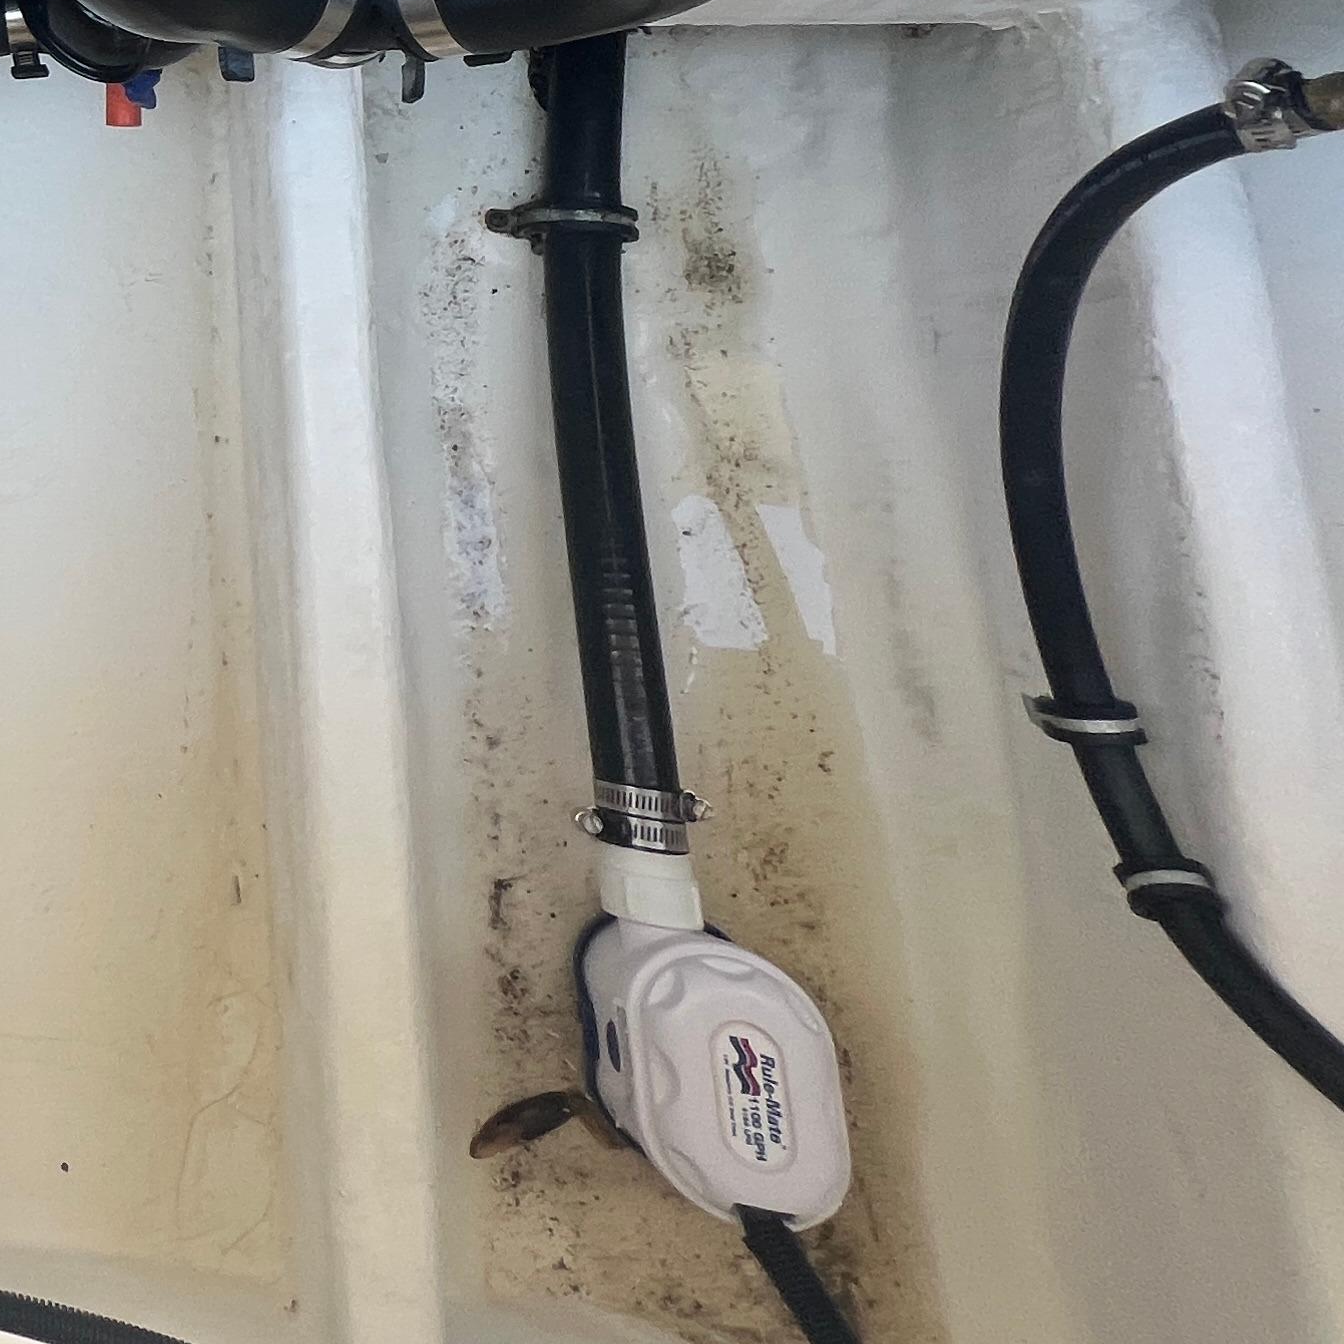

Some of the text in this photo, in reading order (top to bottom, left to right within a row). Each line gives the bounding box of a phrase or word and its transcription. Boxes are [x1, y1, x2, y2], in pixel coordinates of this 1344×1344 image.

[749, 1098, 767, 1162] 1100 GPH
[760, 1054, 784, 1144] Rule-Mate
